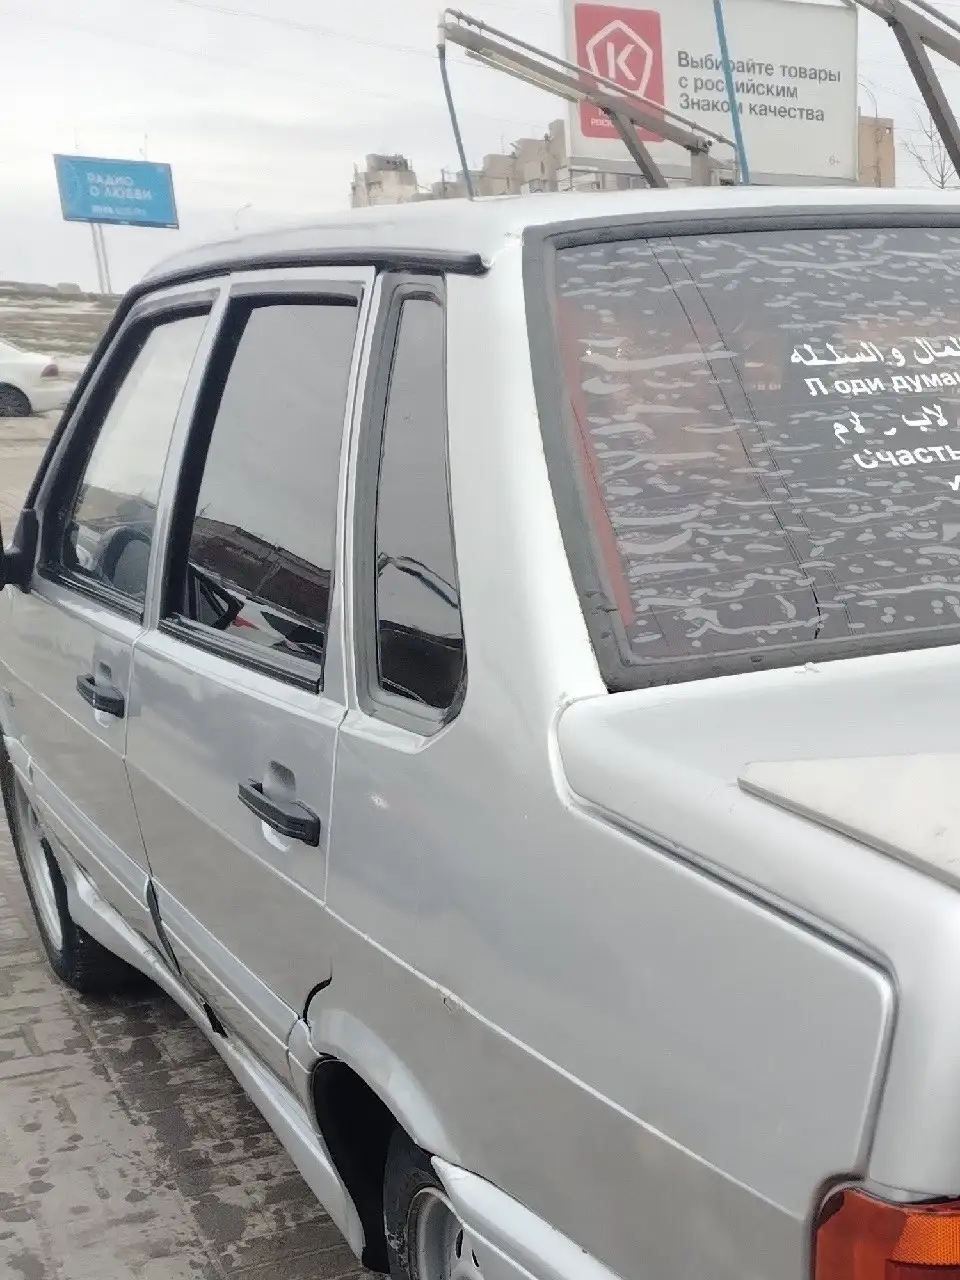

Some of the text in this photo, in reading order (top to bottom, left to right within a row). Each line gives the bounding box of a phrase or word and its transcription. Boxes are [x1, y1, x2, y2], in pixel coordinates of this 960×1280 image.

[780, 64, 841, 84] товары
[678, 76, 799, 99] с росийским
[749, 102, 825, 121] качества
